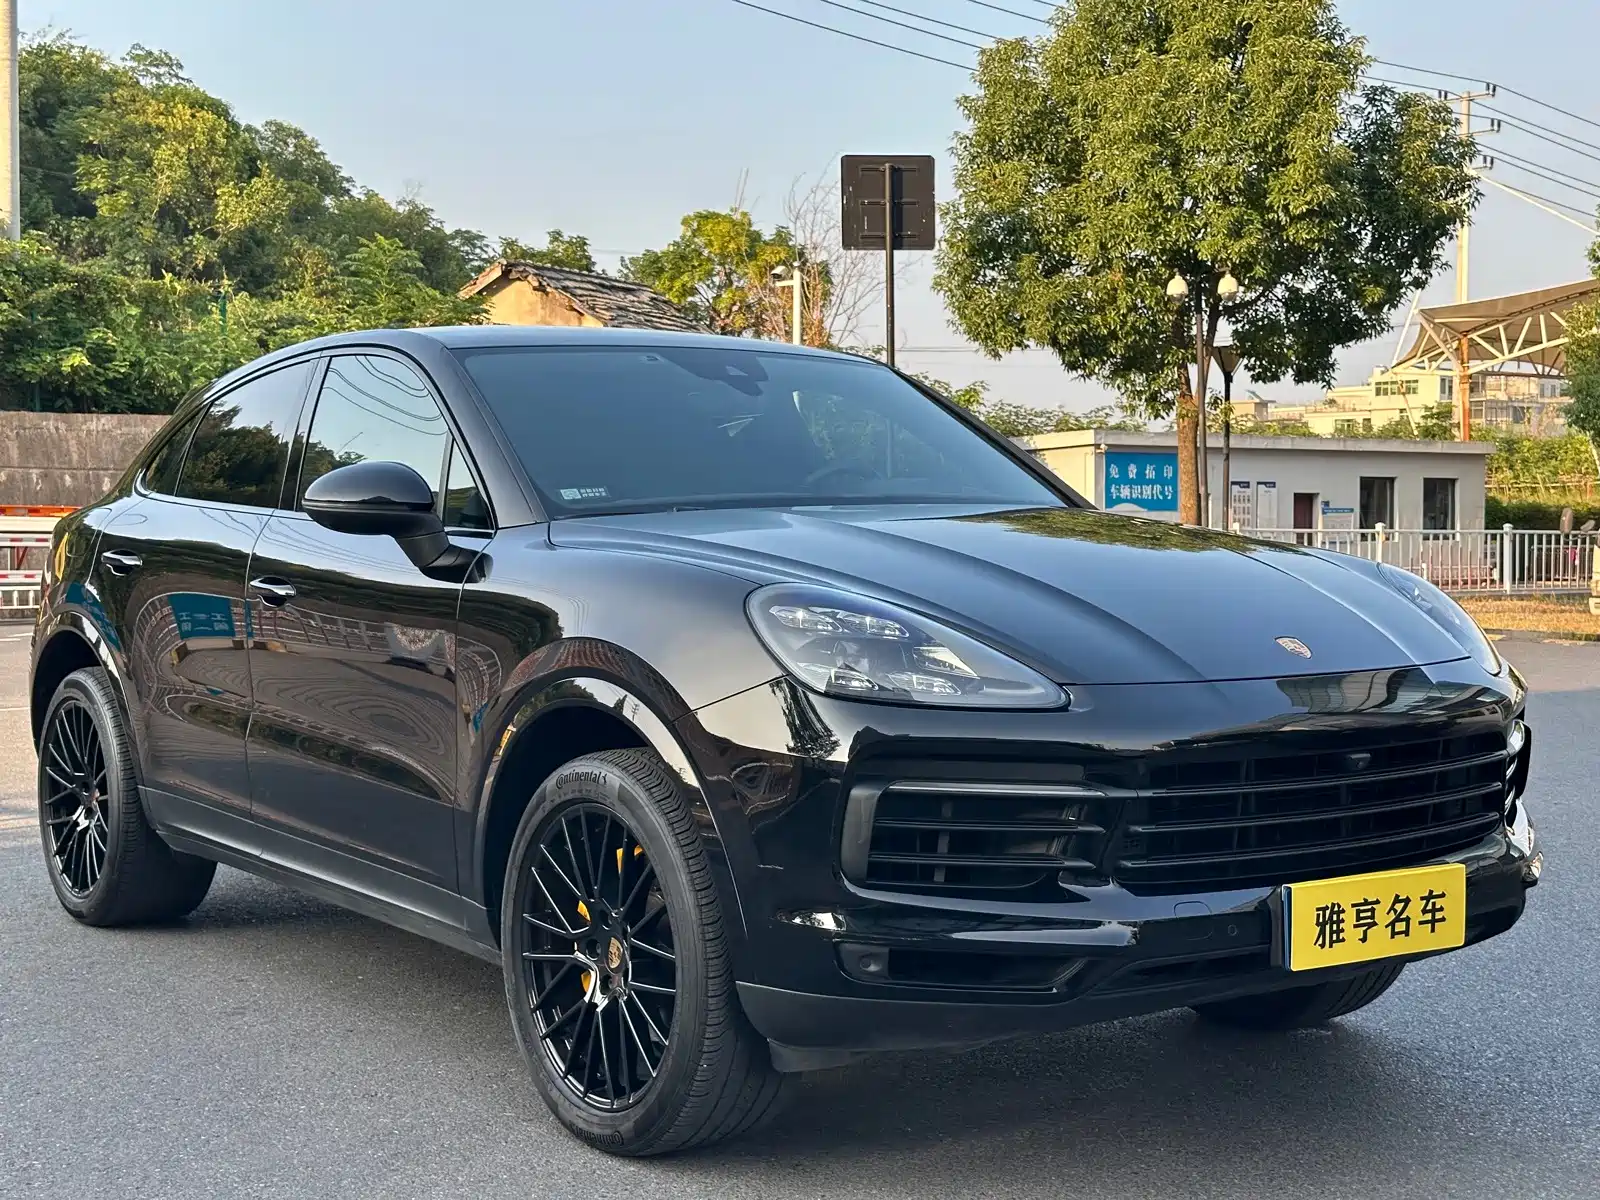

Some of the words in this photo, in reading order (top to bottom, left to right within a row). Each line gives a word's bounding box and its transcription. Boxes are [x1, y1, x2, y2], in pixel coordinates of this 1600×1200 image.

[1110, 483, 1173, 500] 车辆识别代号
[556, 769, 602, 789] Continental
[1313, 889, 1447, 950] 雅亨名车
